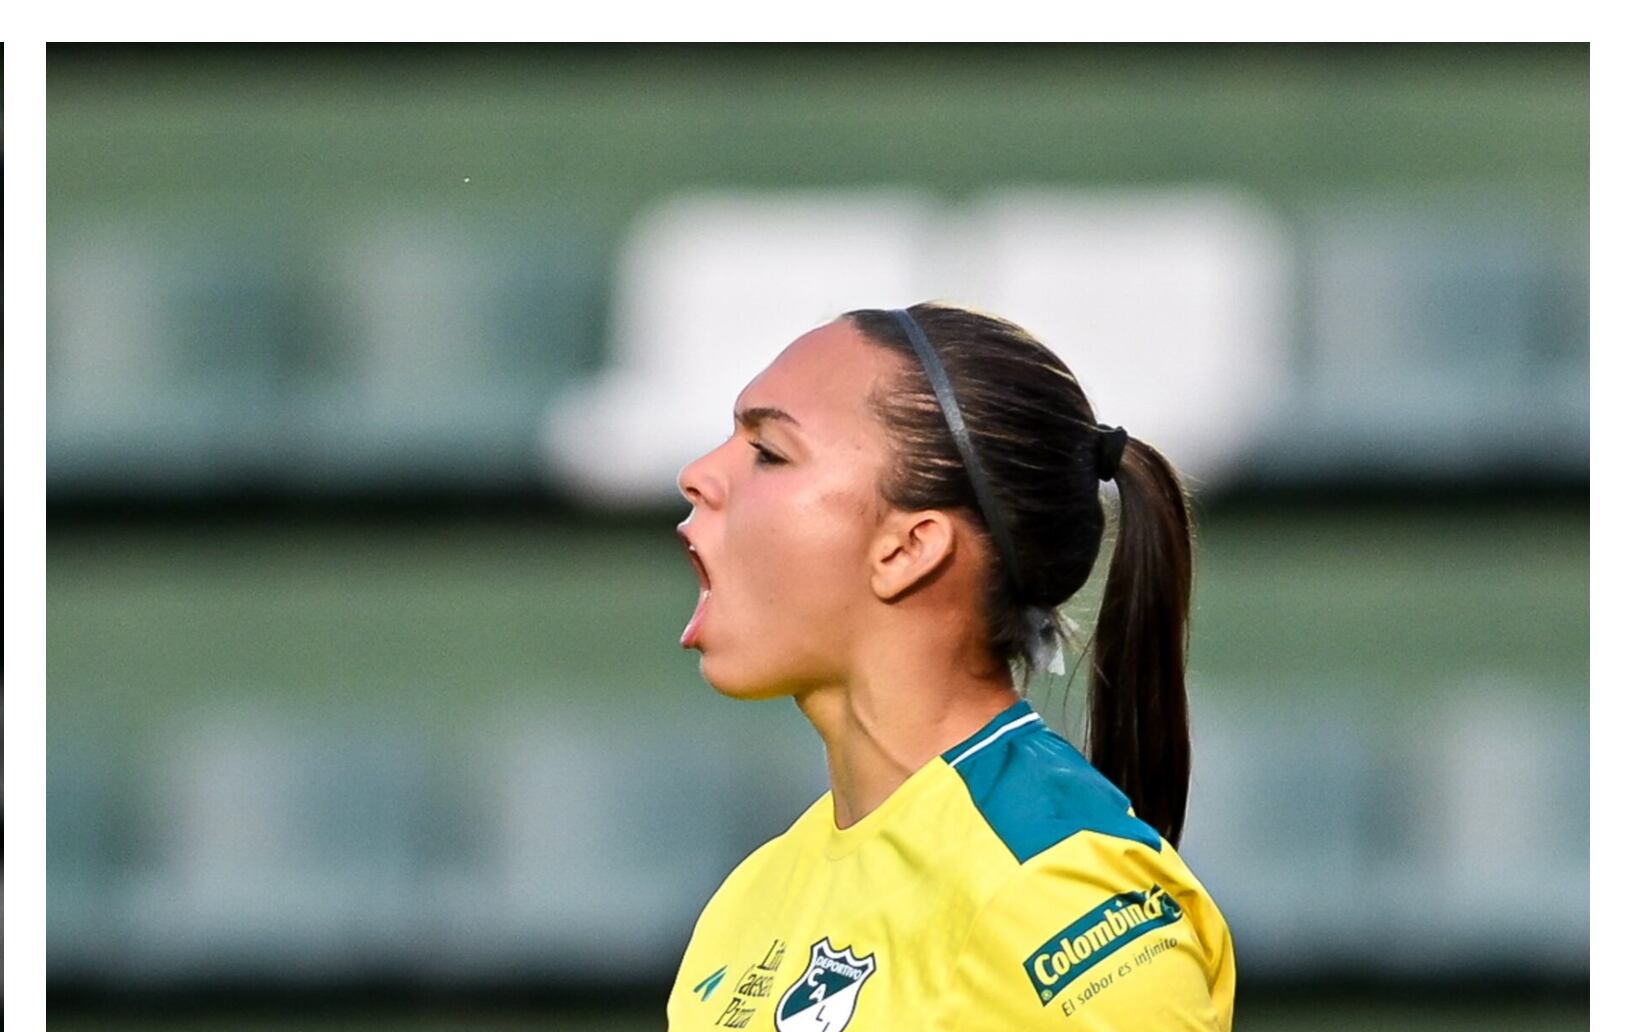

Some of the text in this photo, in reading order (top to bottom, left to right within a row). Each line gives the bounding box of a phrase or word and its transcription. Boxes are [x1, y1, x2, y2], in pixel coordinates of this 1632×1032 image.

[815, 954, 863, 981] DEPORTIVO
[1061, 999, 1076, 1018] El
[1077, 971, 1115, 1006] sabor
[1118, 960, 1132, 977] es
